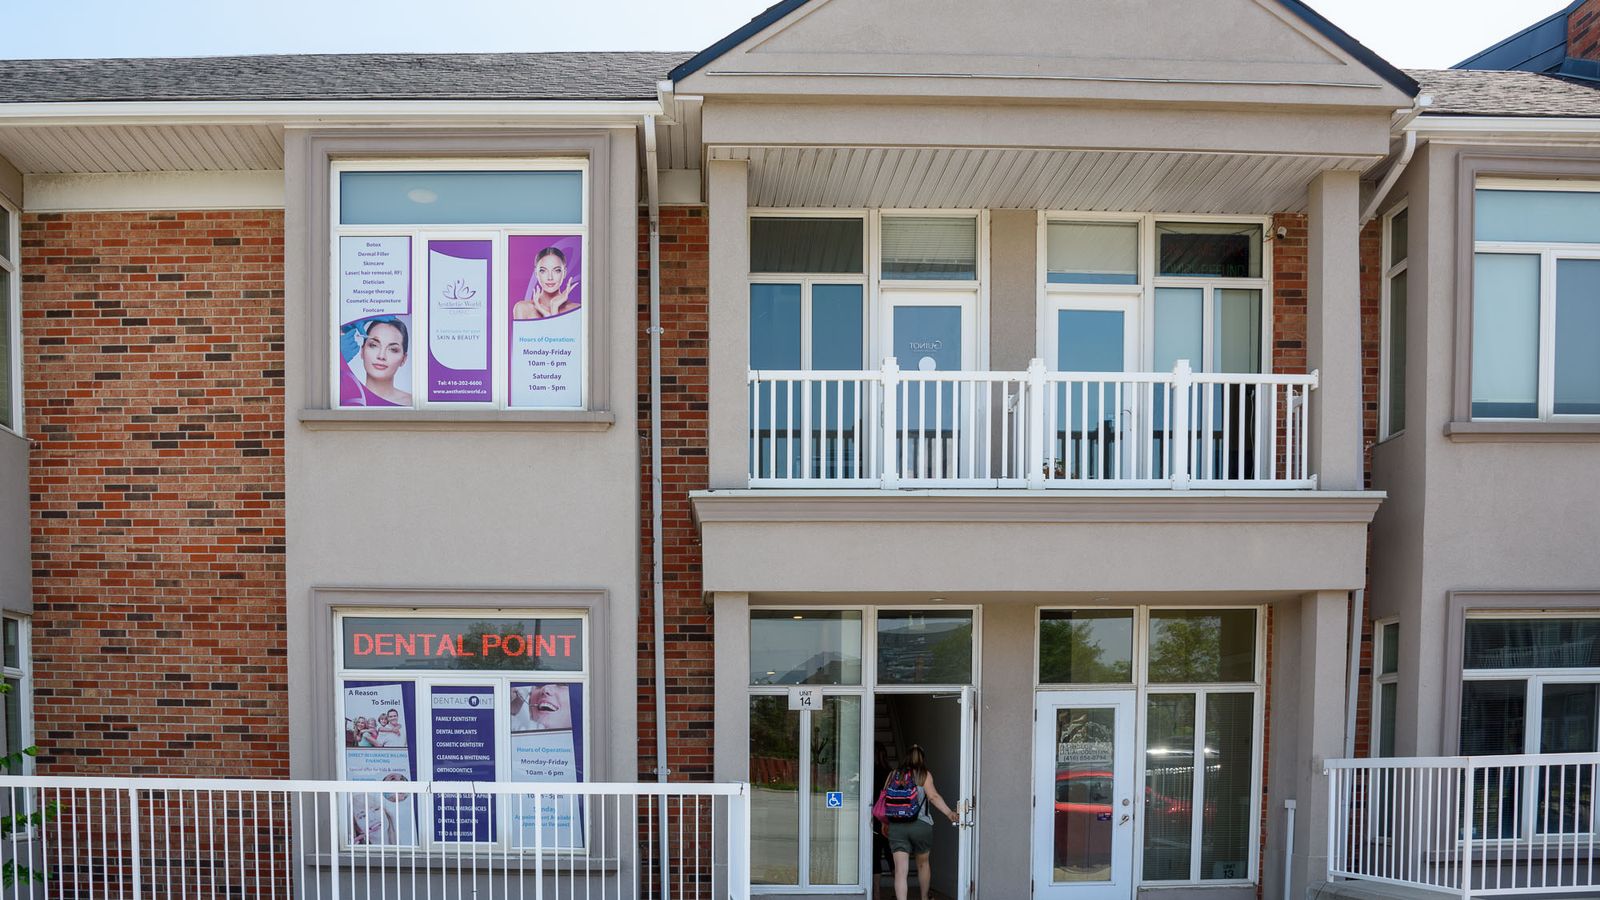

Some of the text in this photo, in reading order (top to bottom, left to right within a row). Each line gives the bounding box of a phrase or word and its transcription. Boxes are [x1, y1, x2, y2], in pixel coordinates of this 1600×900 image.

[353, 633, 577, 657] DENTAL POINT
[799, 697, 811, 706] 14
[520, 758, 569, 766] Monday-Friday
